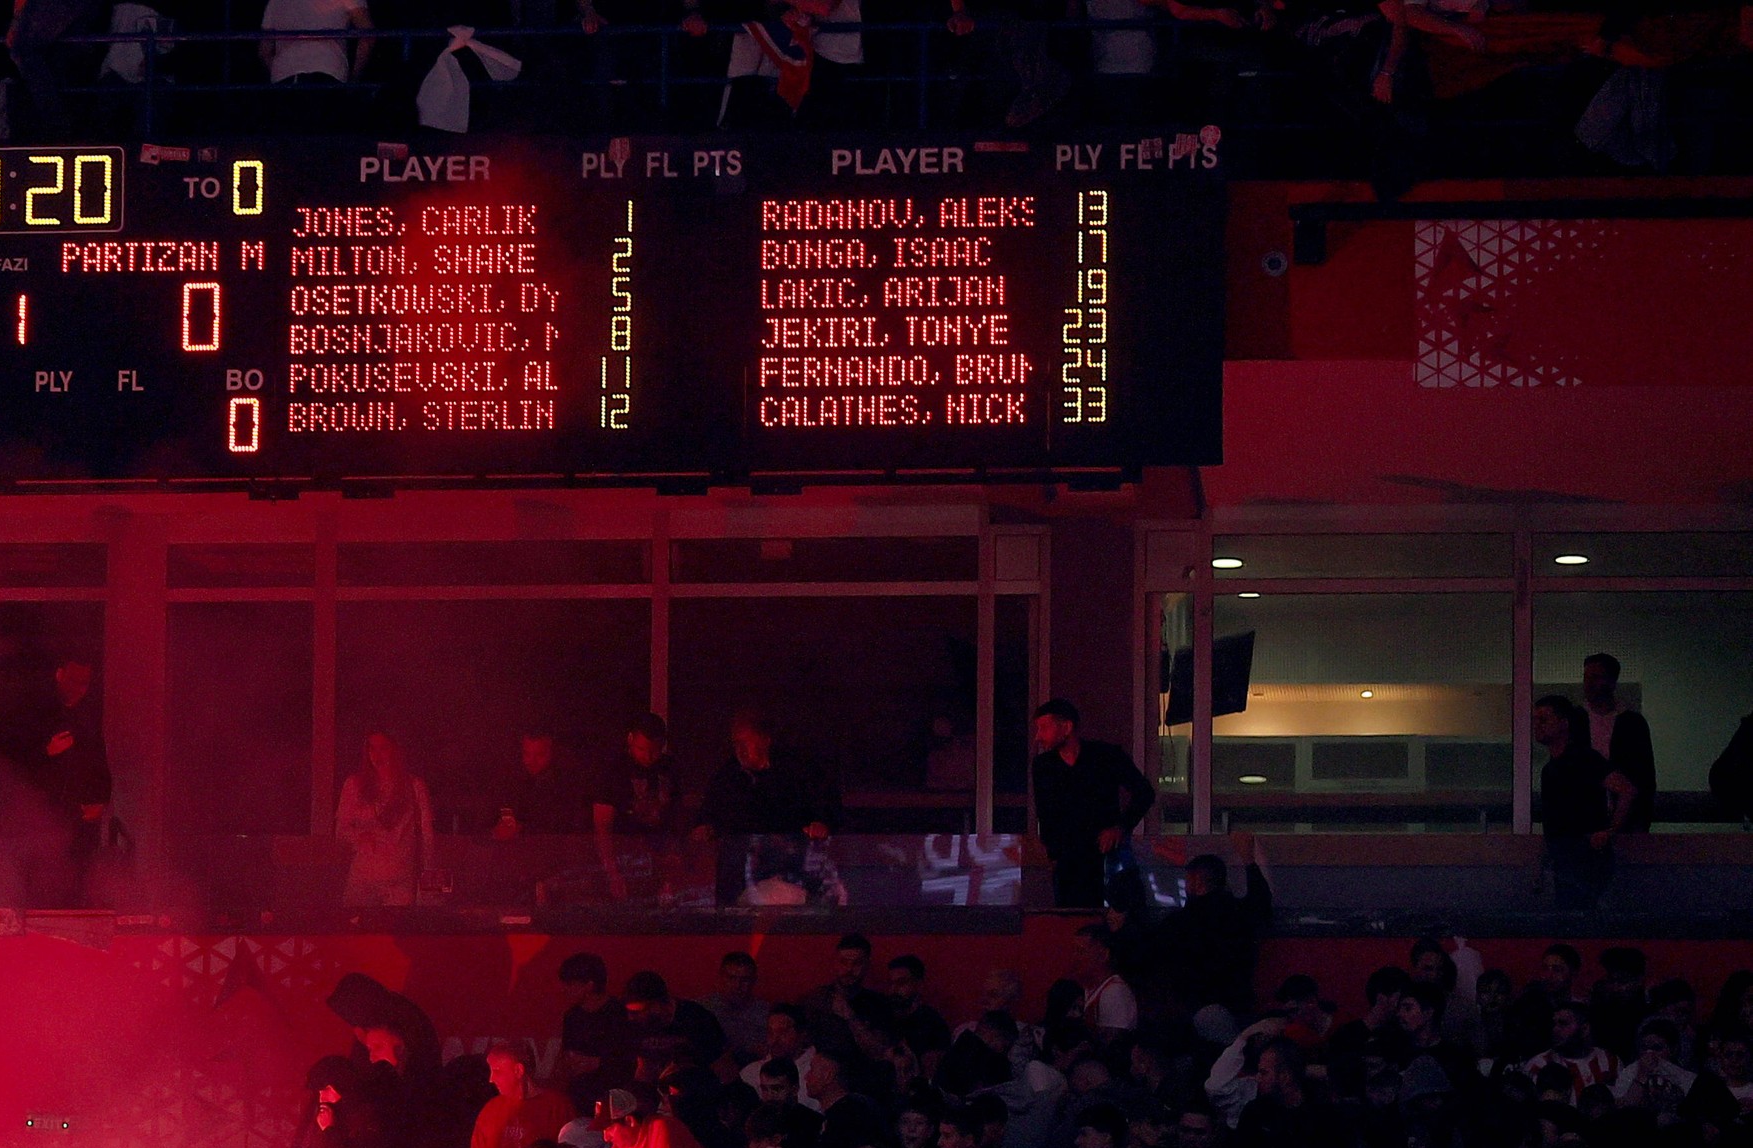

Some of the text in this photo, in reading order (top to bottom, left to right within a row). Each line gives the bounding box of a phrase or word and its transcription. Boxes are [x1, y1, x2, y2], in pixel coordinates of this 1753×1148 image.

[360, 156, 490, 183] PLAYER
[582, 150, 743, 179] PLY FL PTS
[832, 147, 965, 175] PLAYER
[1056, 144, 1103, 171] PLY
[1120, 143, 1153, 170] FL
[183, 177, 220, 199] TO
[232, 159, 264, 216] 0
[292, 203, 538, 239] JONES, CARLIK
[627, 199, 633, 233] 1
[762, 198, 925, 231] RADANOV,
[1078, 190, 1108, 226] 13
[61, 240, 265, 273] PARTIZAN M
[291, 242, 536, 277] MILTON, SHAKE
[612, 237, 633, 273] 2
[761, 236, 992, 270] BONGA, ISAAC
[1077, 229, 1108, 264] 17
[290, 282, 508, 317] OSETKOWSKI,
[612, 276, 632, 312] 5
[761, 275, 1006, 310] LAKIC, ARIJAN
[1077, 268, 1107, 305] 19
[16, 294, 28, 345] 1
[180, 280, 222, 353] 0
[611, 315, 632, 351] 8
[761, 314, 1009, 349] JEKIRI, TONYE
[1062, 307, 1107, 344] 23
[289, 321, 532, 356] BOSNJAKOVIC,
[35, 371, 73, 393] PLY
[118, 370, 144, 392] FL
[225, 368, 264, 391] BO
[289, 359, 560, 394] POKUSEVSKI, AL
[601, 355, 631, 389] 11
[759, 354, 942, 388] FERNANDO,
[1062, 347, 1107, 384] 24
[288, 397, 555, 433] BROWN, STERLIN
[600, 393, 630, 430] 12
[760, 392, 1026, 427] CALATHES, NICK
[1063, 386, 1107, 423] 33
[227, 396, 261, 453] 0
